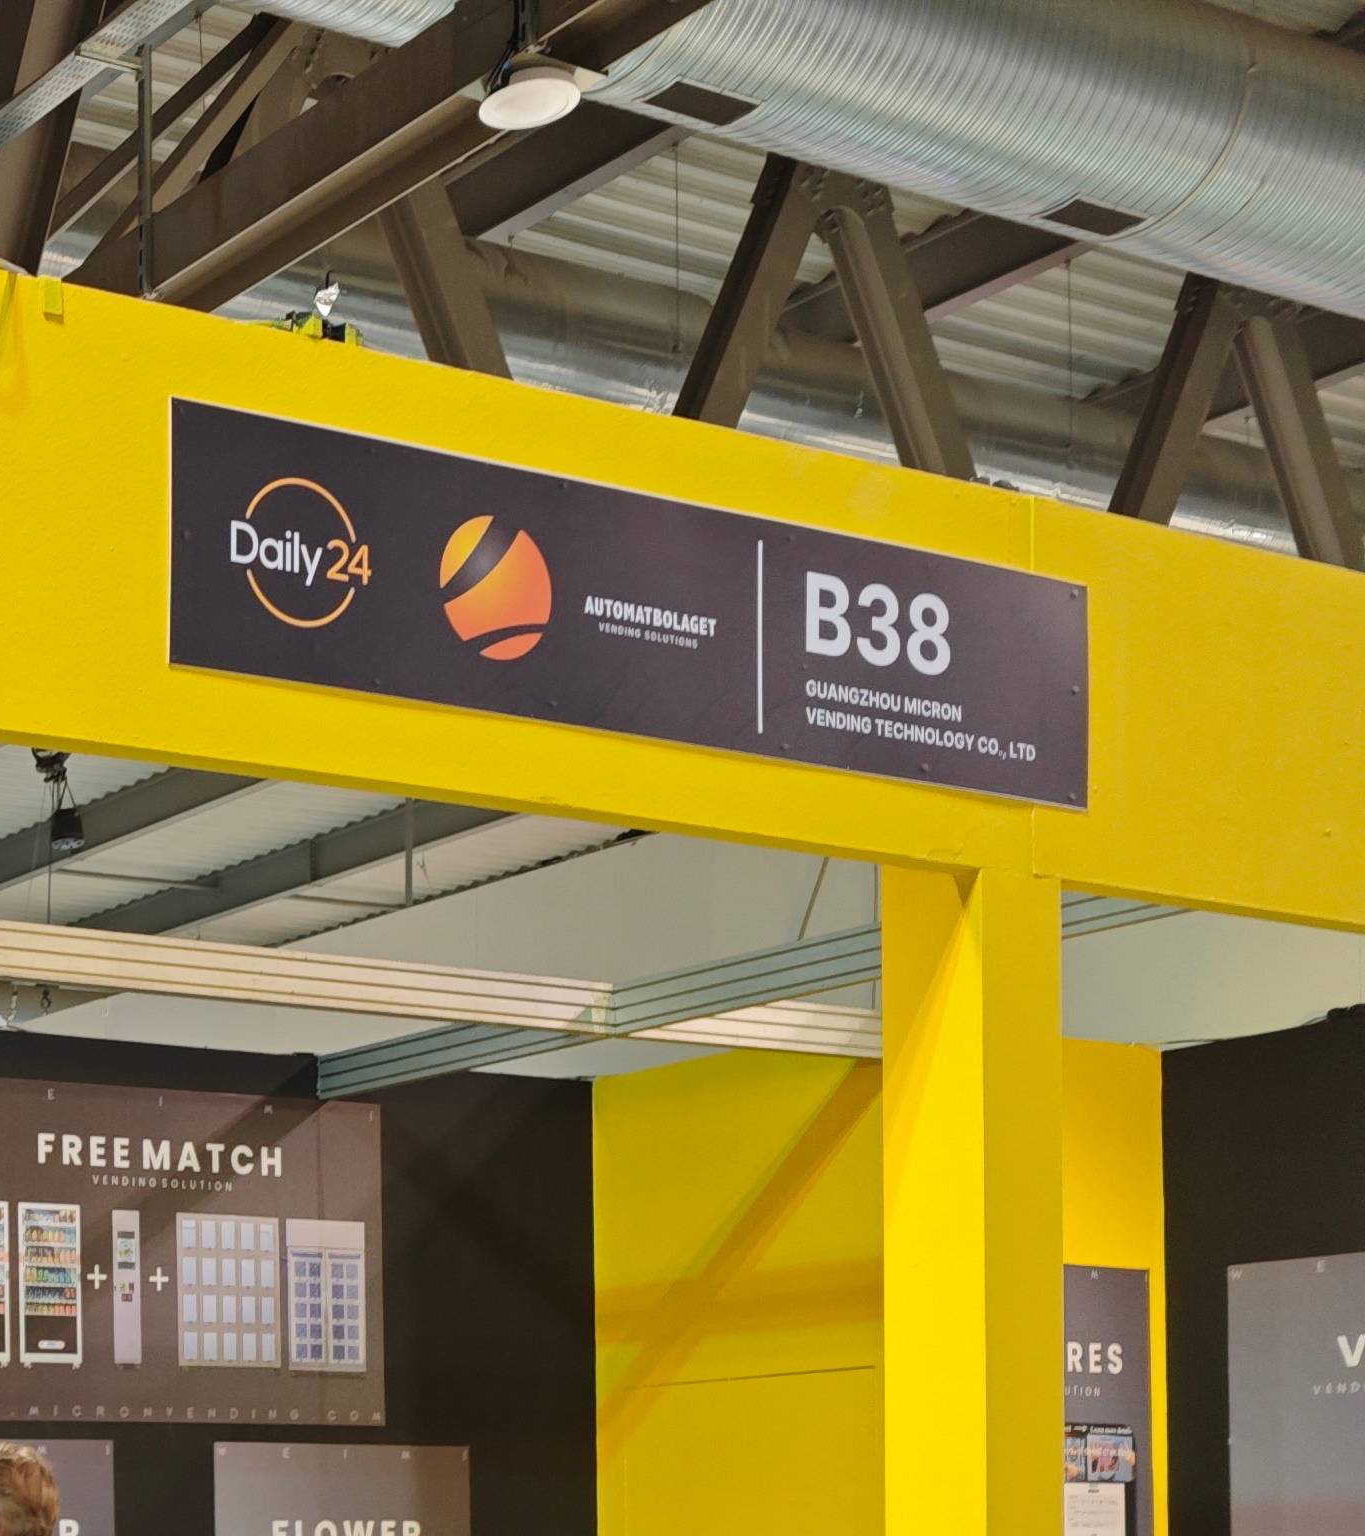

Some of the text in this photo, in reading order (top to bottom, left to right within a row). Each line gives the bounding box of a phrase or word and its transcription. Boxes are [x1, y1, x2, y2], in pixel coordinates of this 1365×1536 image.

[230, 520, 372, 587] Daily24
[583, 595, 717, 637] AUTOMATBOLAGET
[598, 622, 698, 650] VENDING SOLUTIONS
[805, 571, 951, 676] B38
[805, 679, 962, 723] GUANGZHOU MICRON
[805, 706, 872, 734] VENDING
[875, 719, 975, 752] TECHNOLOGY
[1009, 740, 1036, 762] LTD
